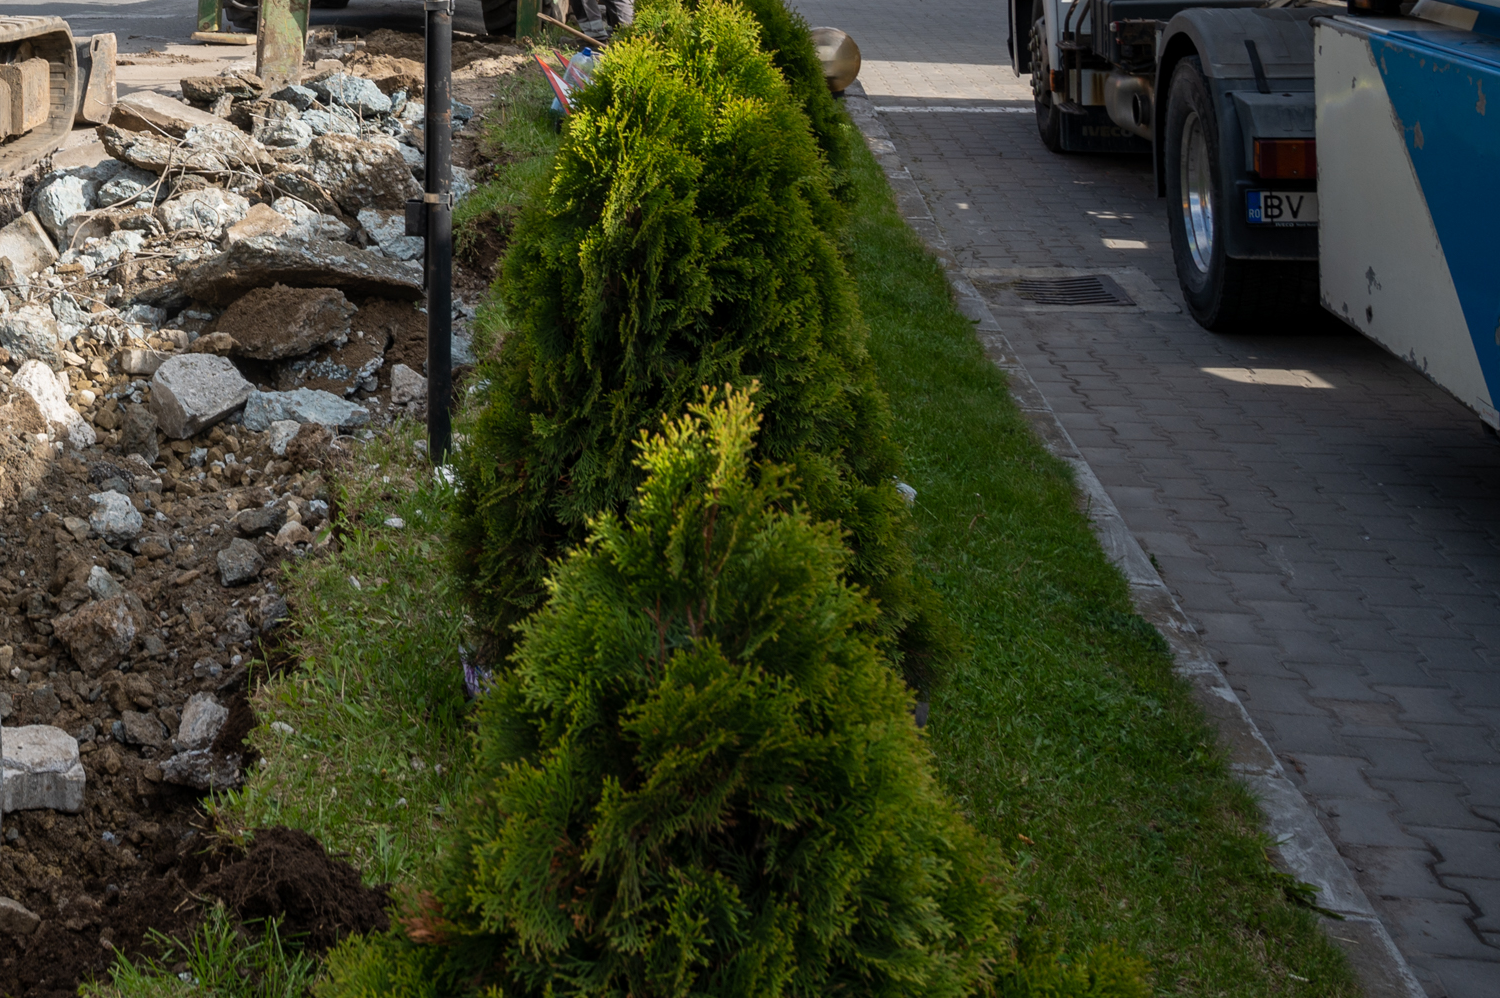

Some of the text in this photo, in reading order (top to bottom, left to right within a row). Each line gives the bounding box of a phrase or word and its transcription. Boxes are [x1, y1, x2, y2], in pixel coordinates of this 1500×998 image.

[1081, 125, 1134, 137] IVECO
[1263, 194, 1305, 219] BV
[1248, 208, 1261, 219] RO
